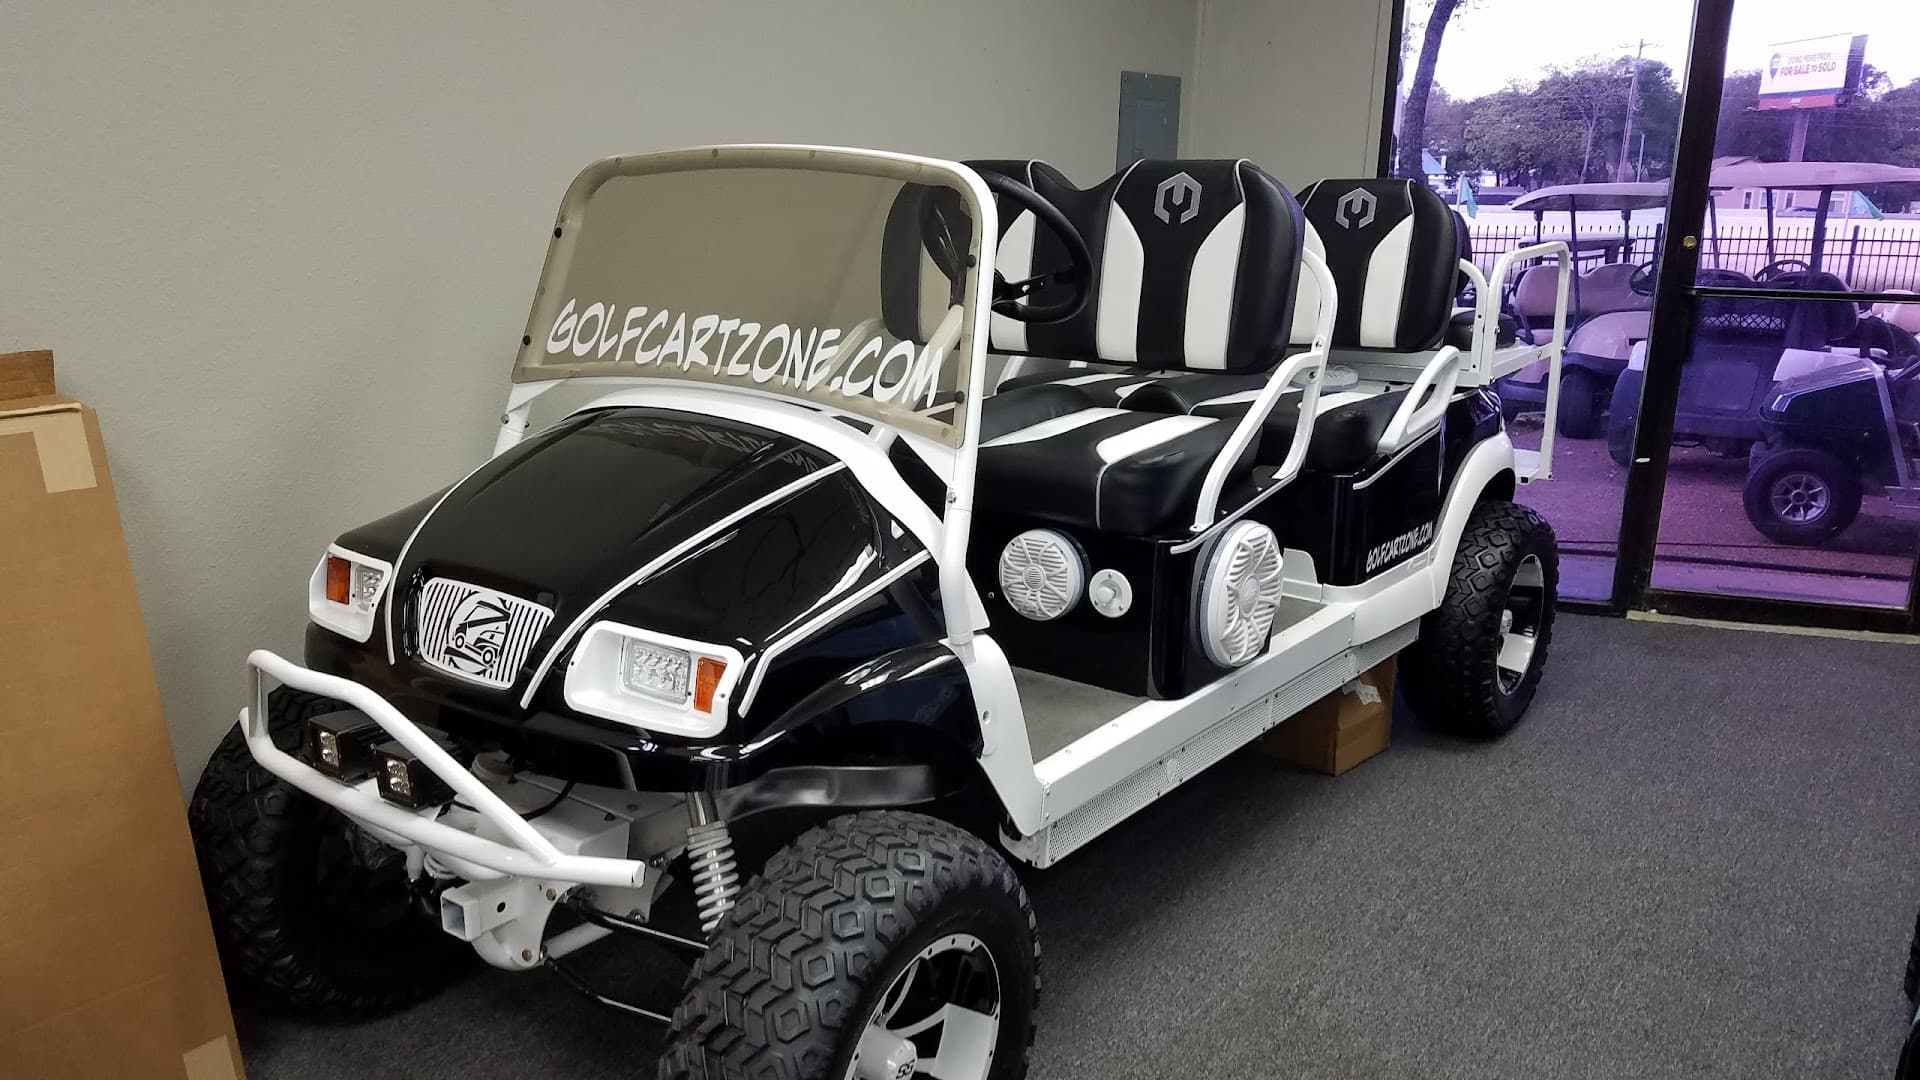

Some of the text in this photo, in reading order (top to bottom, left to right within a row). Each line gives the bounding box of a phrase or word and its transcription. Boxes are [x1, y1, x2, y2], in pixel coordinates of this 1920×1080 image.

[1780, 65, 1794, 76] FOR
[1794, 63, 1810, 75] SALE
[1818, 61, 1837, 73] SOLD
[546, 298, 944, 408] GOLFCARTZONE.COM
[1366, 521, 1433, 574] GOLFCARTZONE.COM
